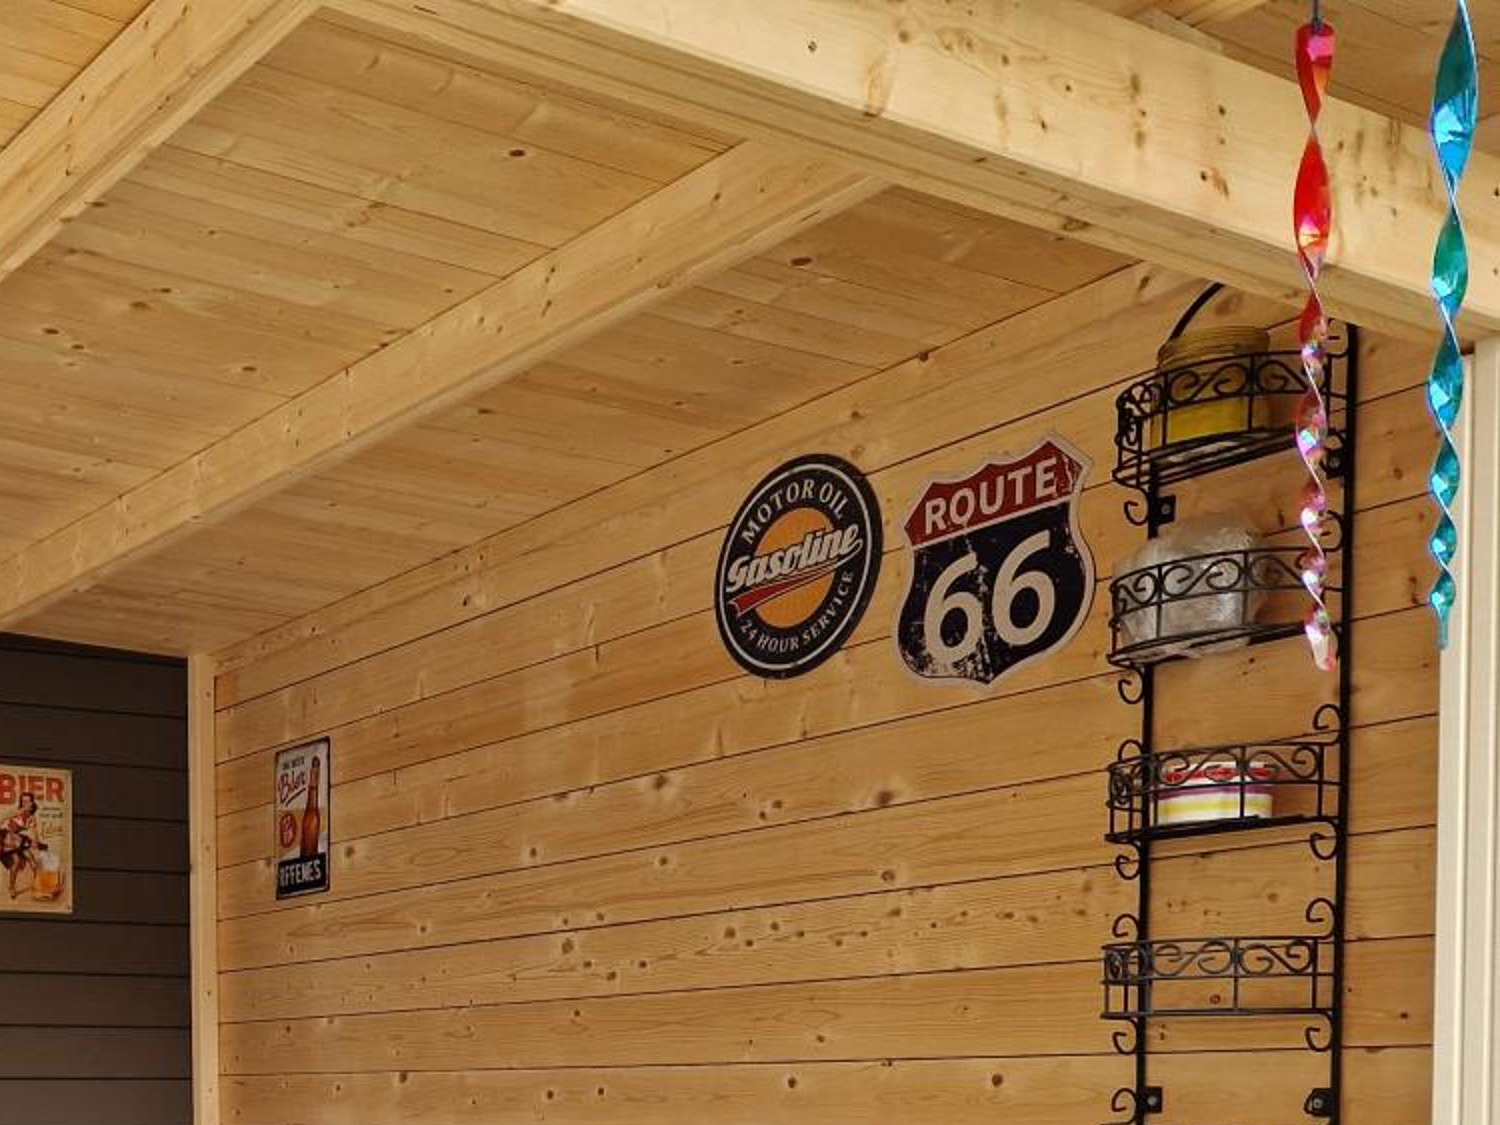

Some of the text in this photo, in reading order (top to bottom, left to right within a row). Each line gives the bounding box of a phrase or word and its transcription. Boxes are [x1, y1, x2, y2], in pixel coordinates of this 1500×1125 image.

[741, 479, 850, 544] MOTOR OIL
[924, 457, 1058, 535] ROUTE
[726, 523, 861, 593] Gasoline
[756, 634, 800, 653] HOUR
[802, 571, 853, 643] SERVICE
[923, 529, 1055, 667] 66
